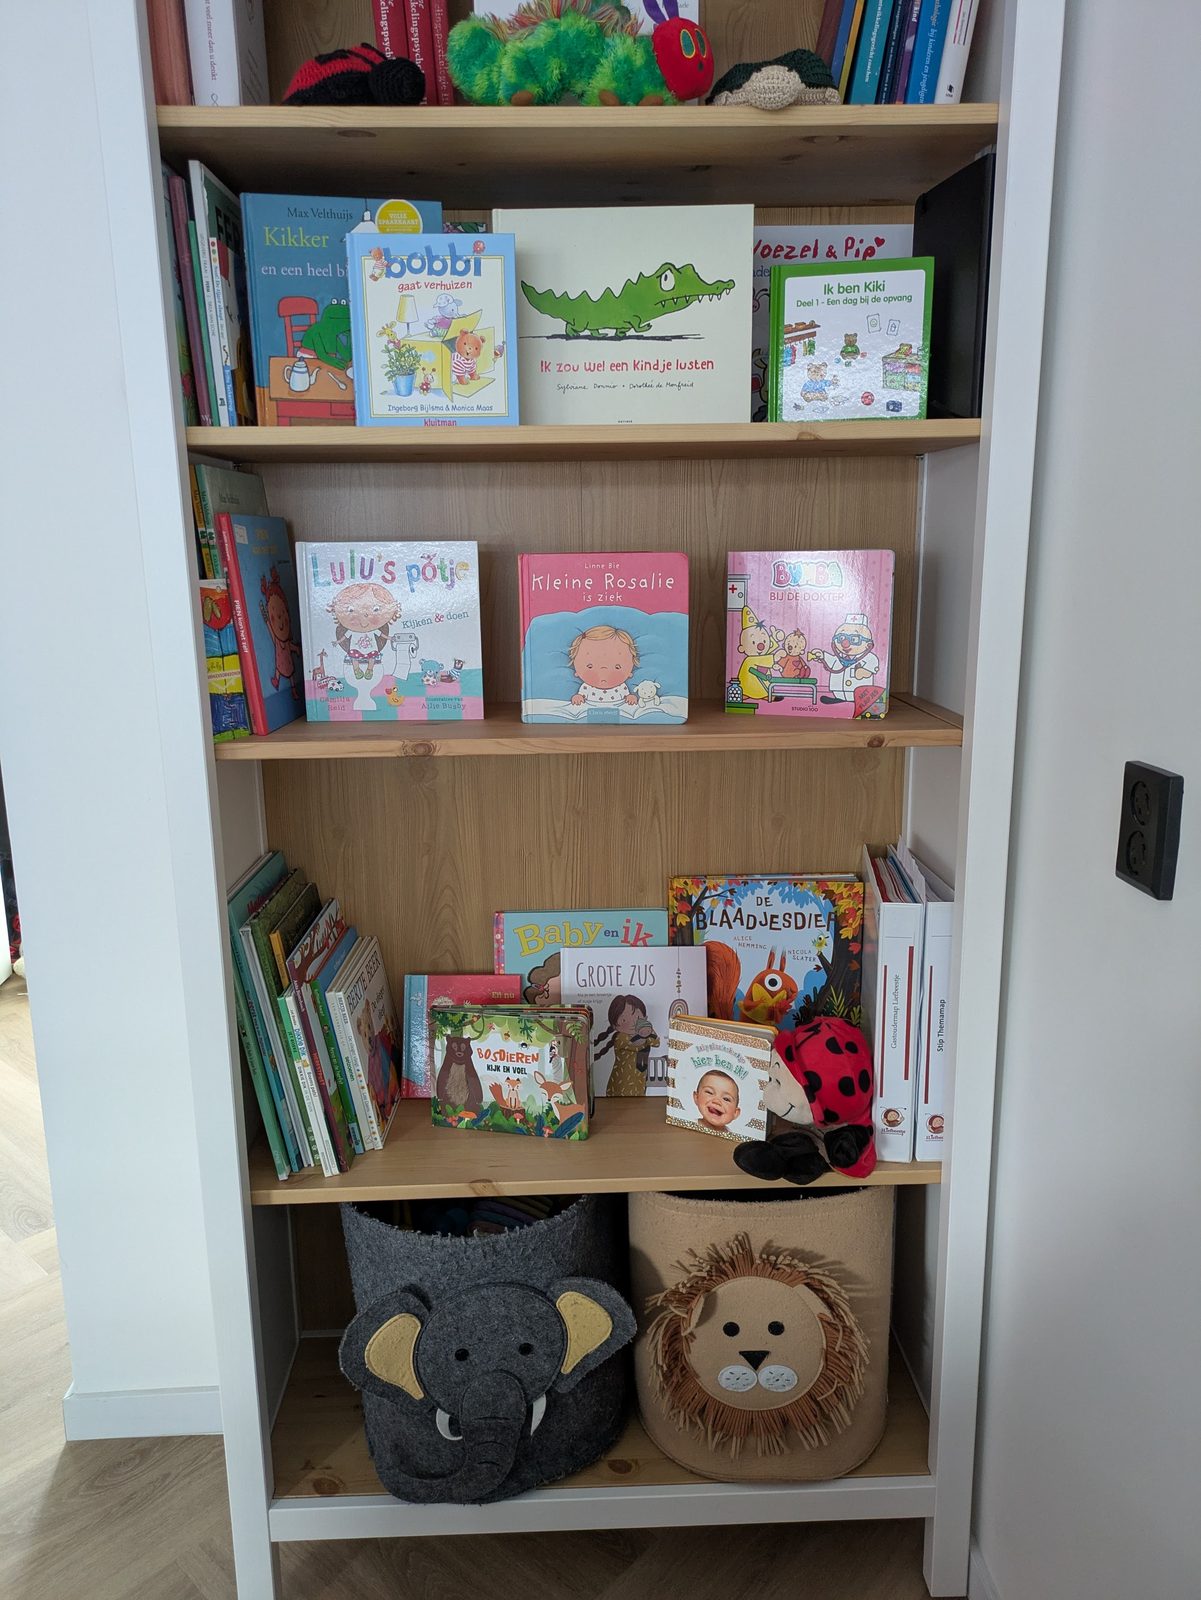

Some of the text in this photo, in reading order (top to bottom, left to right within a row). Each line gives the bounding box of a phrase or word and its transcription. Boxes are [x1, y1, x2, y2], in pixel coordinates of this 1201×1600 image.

[912, 6, 920, 22] kind
[924, 38, 936, 64] kinderen
[923, 64, 930, 74] en
[287, 207, 353, 221] Max Velthuijs
[264, 226, 330, 248] Kikker
[826, 244, 838, 260] &
[844, 236, 876, 261] Pip
[383, 240, 486, 279] bobbi
[261, 262, 332, 277] en een heel
[398, 280, 472, 293] gaat verhuizen
[824, 280, 886, 295] Ik ben Kiki
[796, 299, 814, 308] Deel
[826, 298, 840, 306] Een
[842, 296, 858, 306] dag
[860, 296, 870, 306] bij
[870, 295, 881, 304] de
[882, 294, 913, 304] opvang
[556, 363, 580, 373] zou
[610, 362, 629, 372] een
[676, 358, 714, 370] lusten
[388, 404, 419, 412] Ingeborg
[420, 404, 444, 412] Bijlsma
[451, 404, 474, 412] Monica
[476, 404, 494, 412] Maas
[424, 418, 457, 426] kluitman
[310, 550, 397, 588] Lulu's
[532, 572, 675, 592] Kleine Rosalie
[582, 592, 592, 602] is
[770, 592, 844, 601] BIJ DE DOKTER
[402, 616, 432, 630] Kijken
[446, 610, 469, 620] doen
[756, 896, 773, 906] DE
[513, 917, 654, 957] Baby en ik
[738, 942, 768, 950] HEMMING
[891, 1006, 900, 1049] Gastoudermap
[936, 999, 946, 1052] Stip Themamap
[344, 1056, 354, 1082] seizoenen
[486, 1064, 528, 1075] KIJK EN VOEL
[690, 1056, 713, 1068] hier
[714, 1054, 734, 1072] ben
